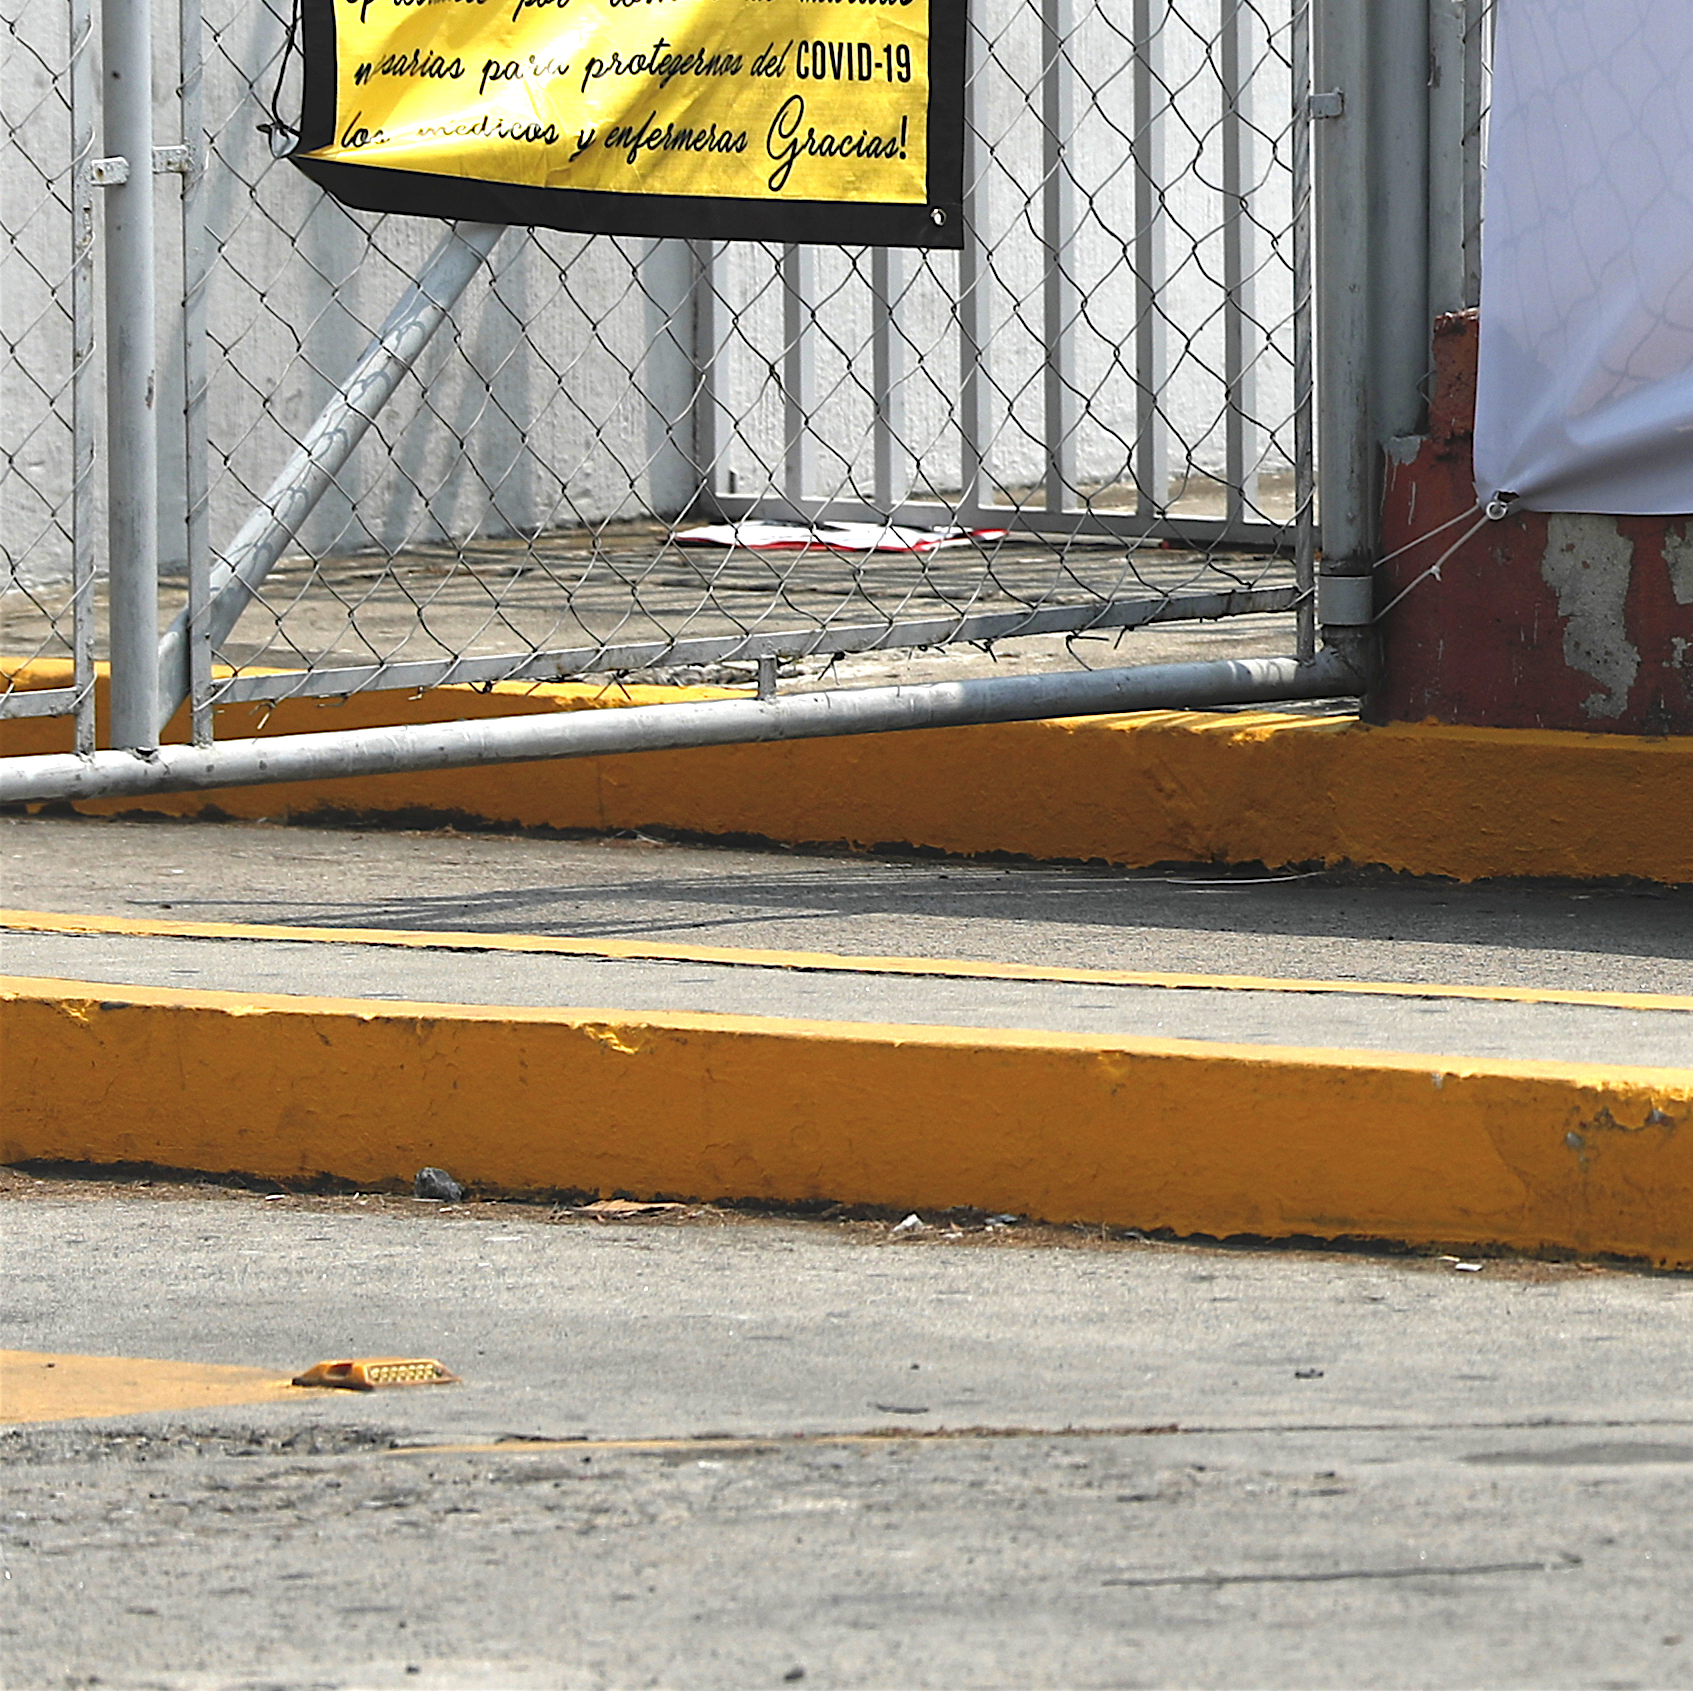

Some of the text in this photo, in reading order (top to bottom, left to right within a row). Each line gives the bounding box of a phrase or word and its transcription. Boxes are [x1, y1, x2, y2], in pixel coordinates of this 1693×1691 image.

[581, 37, 743, 93] protegernos
[750, 39, 794, 78] del
[796, 39, 911, 83] COVID-19
[569, 127, 597, 163] y
[603, 111, 748, 165] enfermeras
[766, 94, 908, 192] Gracias!
